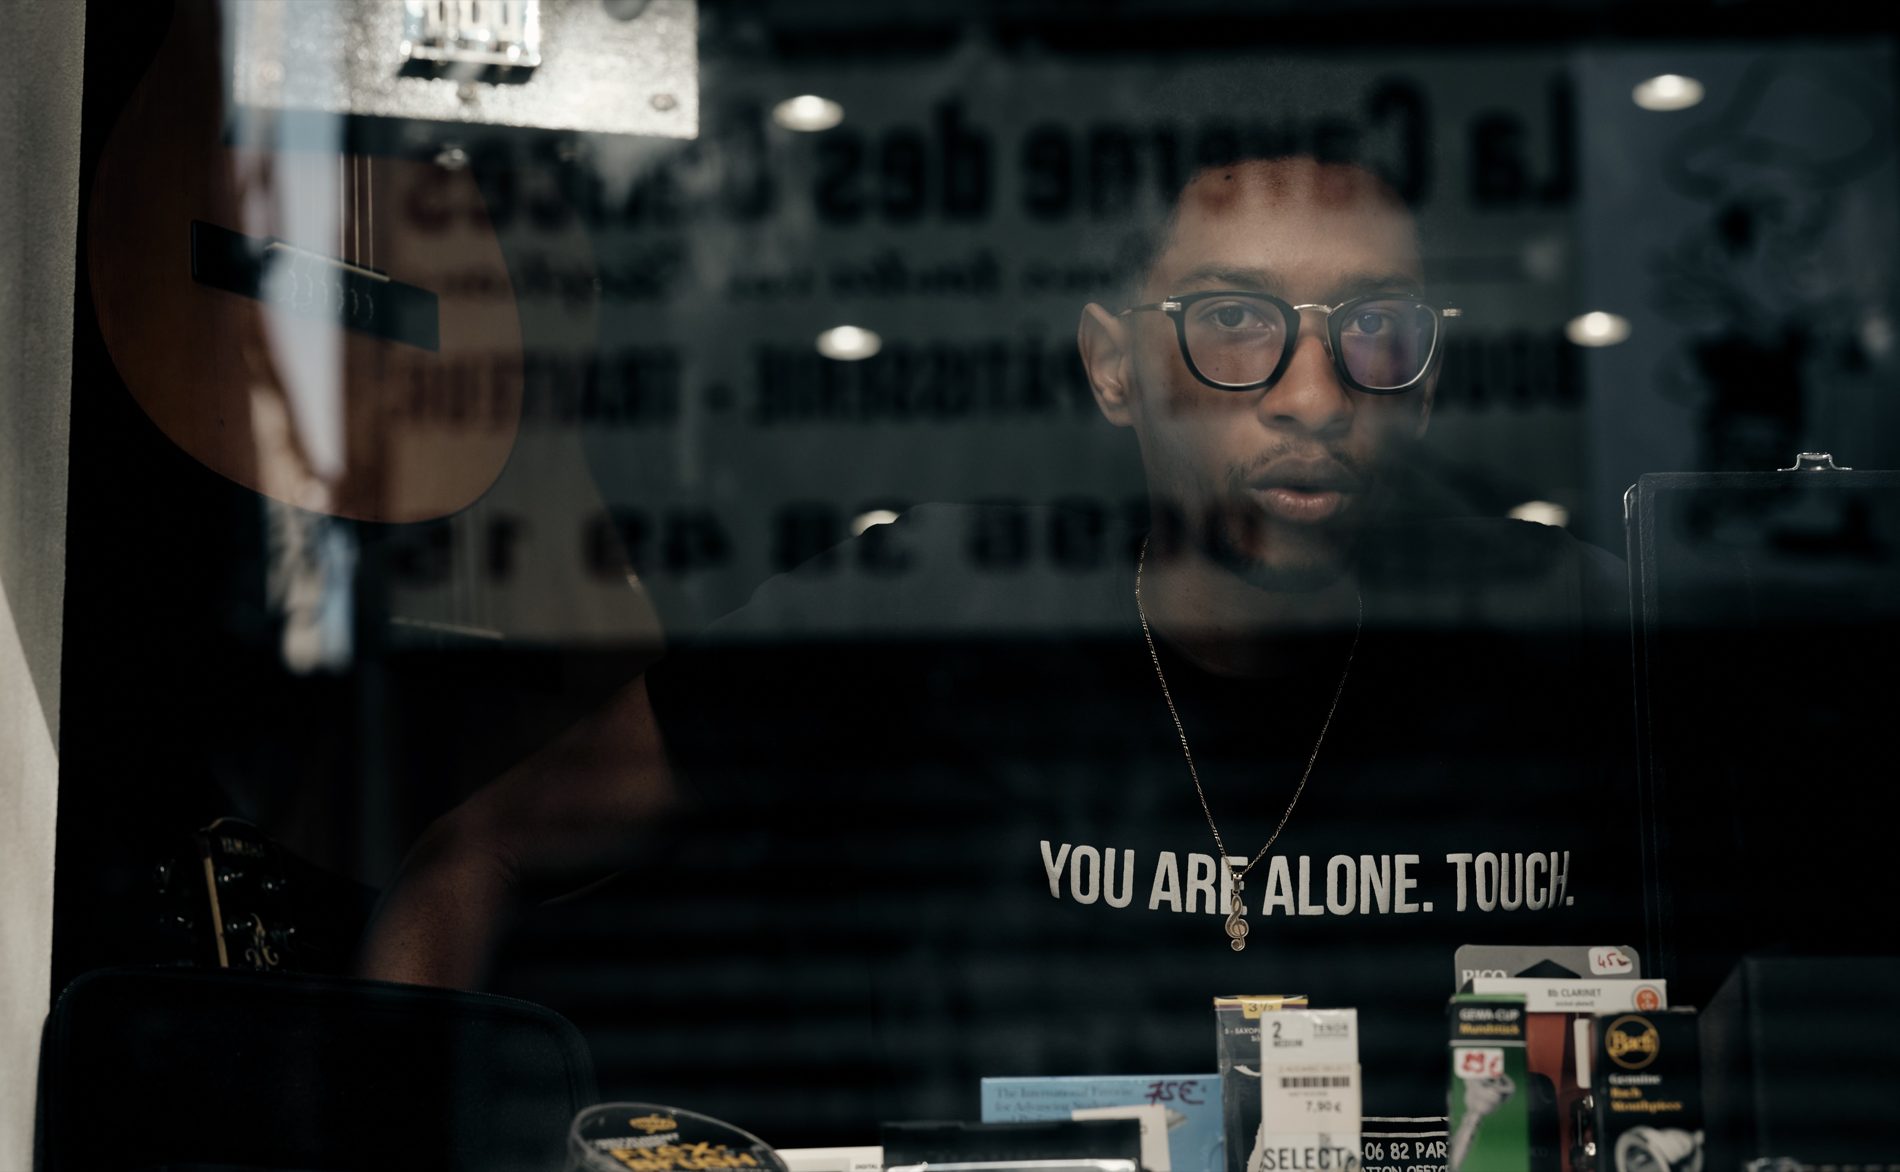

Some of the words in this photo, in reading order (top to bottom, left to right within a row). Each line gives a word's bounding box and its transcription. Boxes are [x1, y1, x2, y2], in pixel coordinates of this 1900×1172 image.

[1040, 840, 1134, 908] YOU
[1148, 851, 1248, 916] ARE
[1262, 854, 1433, 916] ALONE.
[1447, 850, 1575, 912] TOUCH.
[1561, 988, 1601, 997] CLARINET
[1272, 1021, 1282, 1038] 2
[1390, 1142, 1410, 1160] 82
